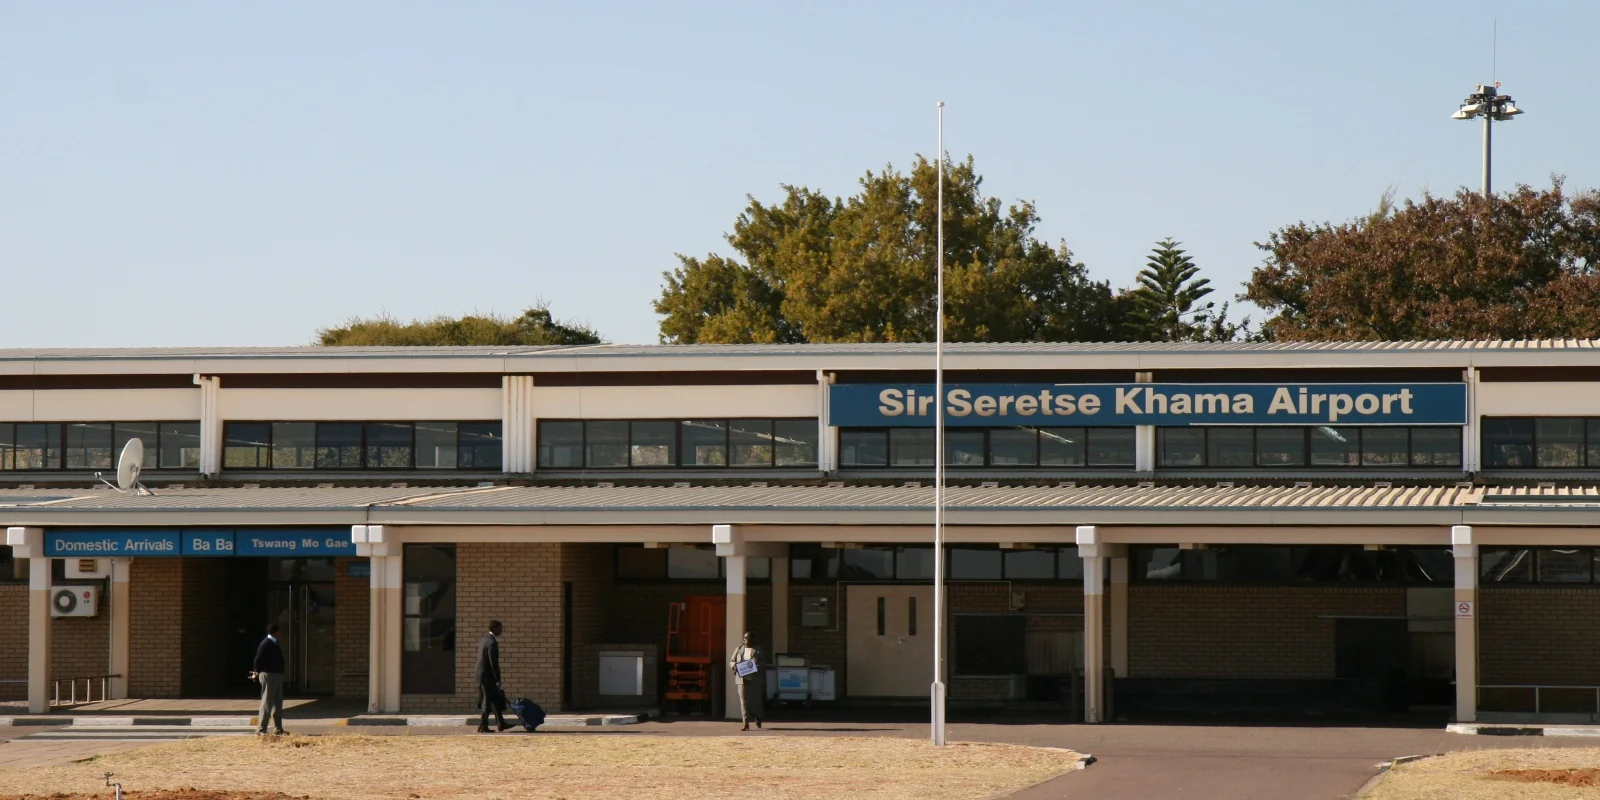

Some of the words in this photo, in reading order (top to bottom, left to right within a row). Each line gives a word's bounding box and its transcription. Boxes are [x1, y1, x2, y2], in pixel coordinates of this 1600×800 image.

[879, 388, 933, 416] Sir
[946, 388, 1101, 416] Seretse
[1115, 386, 1254, 414] Khama
[1268, 386, 1413, 421] Airport
[55, 539, 118, 551] Domestic
[124, 538, 174, 551] Arrivals
[192, 538, 211, 551] Ba
[215, 538, 234, 551] Ba
[252, 538, 297, 550] Tswang
[302, 538, 319, 548] Mo
[325, 538, 349, 548] Gae
